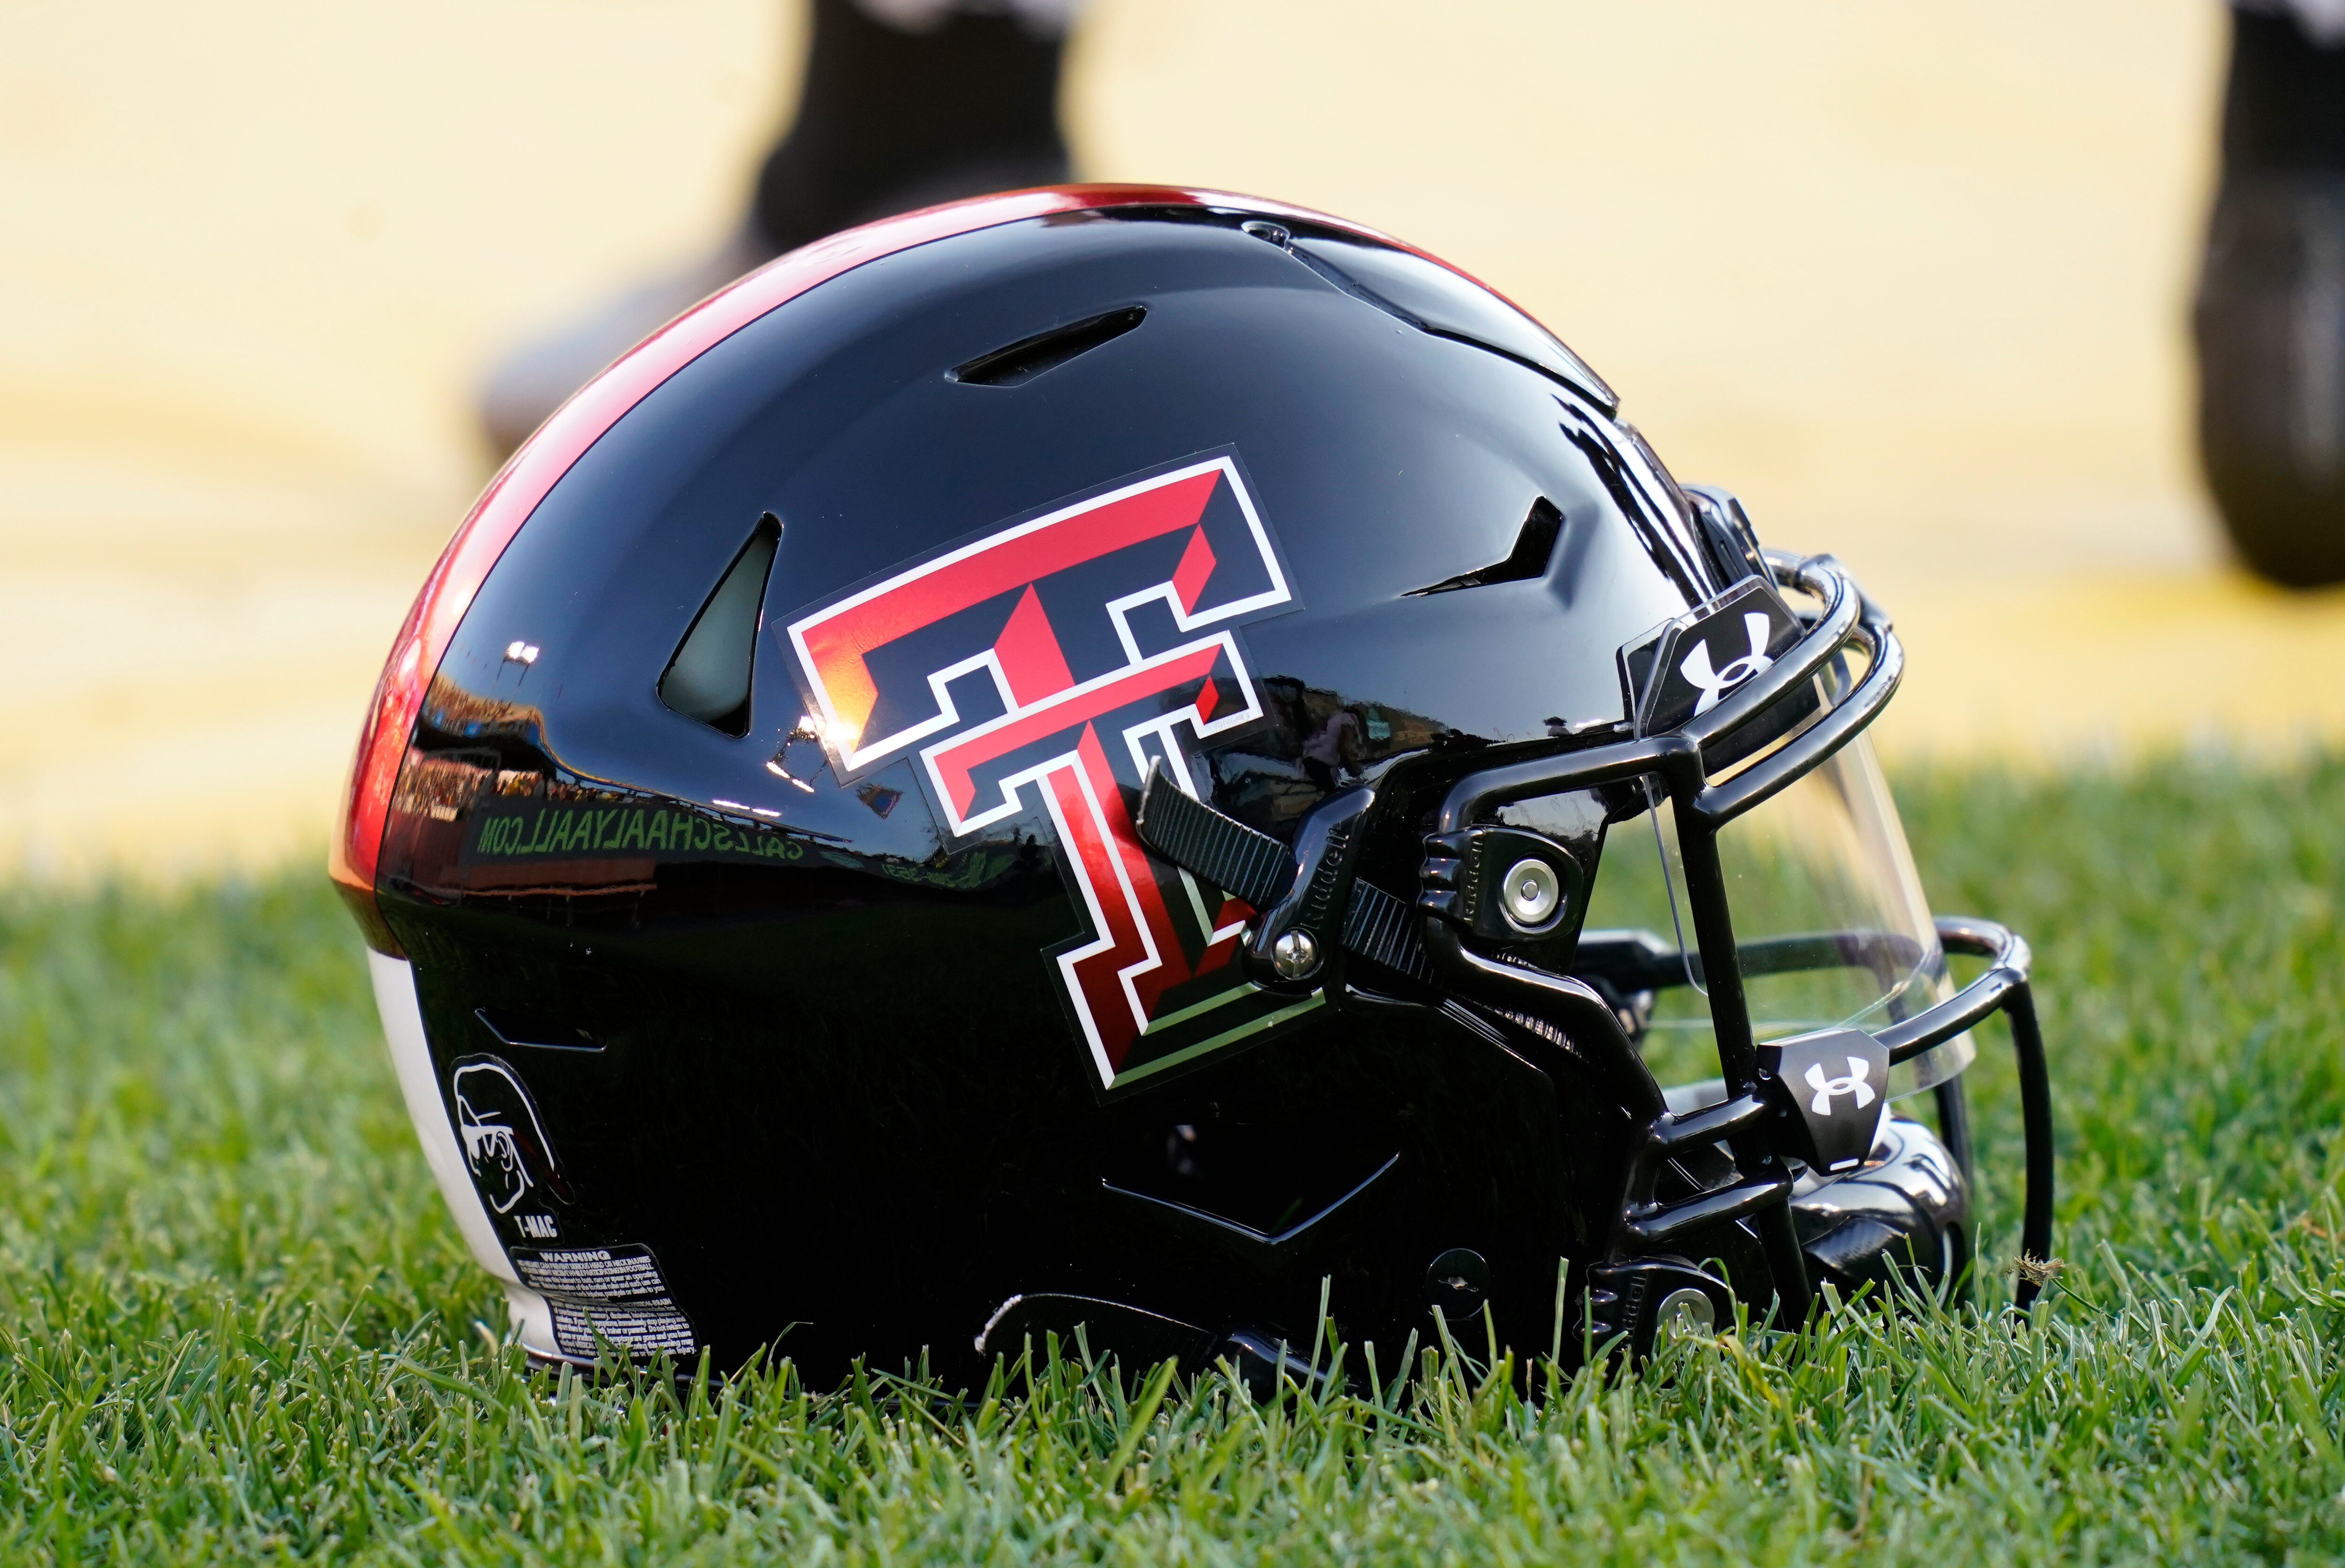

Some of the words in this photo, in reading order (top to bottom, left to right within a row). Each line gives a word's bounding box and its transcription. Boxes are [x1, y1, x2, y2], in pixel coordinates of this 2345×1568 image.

[514, 1215, 558, 1238] T-MAC
[539, 1251, 611, 1262] WARNING
[627, 1256, 651, 1265] INJURIES
[633, 1271, 658, 1281] opposing
